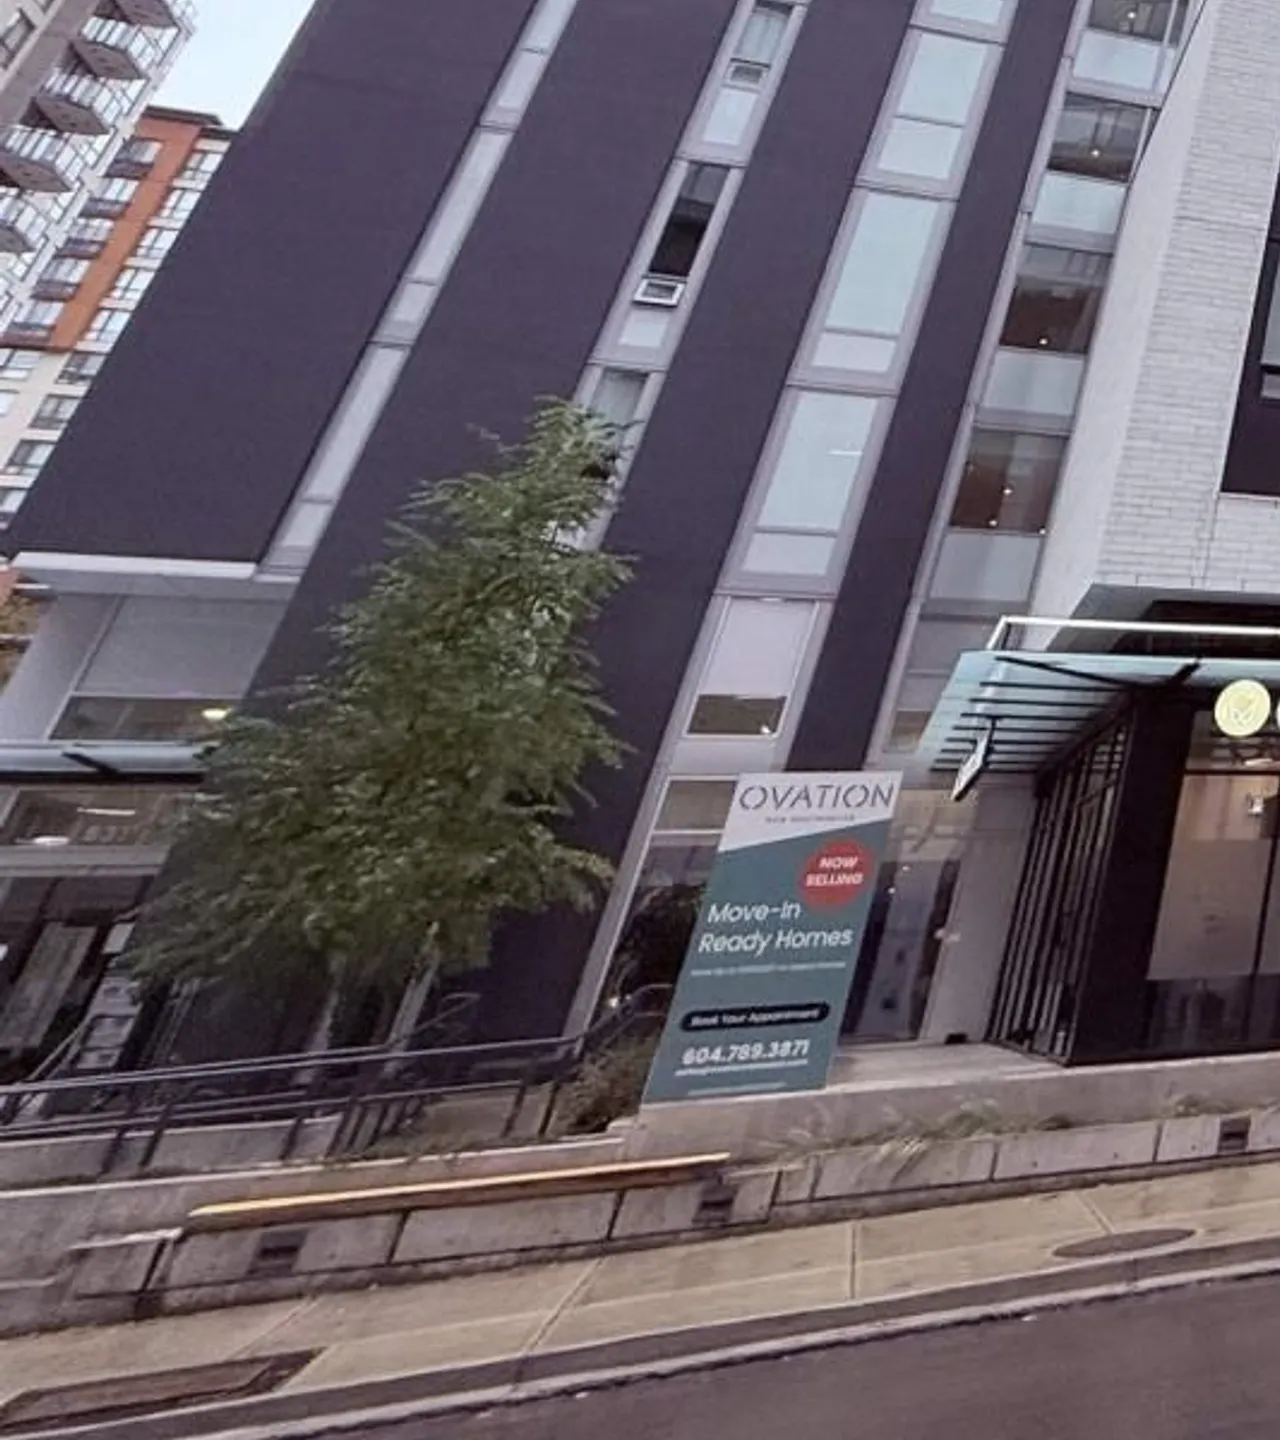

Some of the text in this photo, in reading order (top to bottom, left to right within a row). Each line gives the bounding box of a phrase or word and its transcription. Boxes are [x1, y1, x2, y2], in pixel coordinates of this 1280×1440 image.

[739, 783, 895, 811] OVATION
[819, 856, 859, 869] NOW
[805, 873, 864, 887] SELLING
[707, 900, 801, 923] Move-in
[698, 927, 853, 957] Ready Homes
